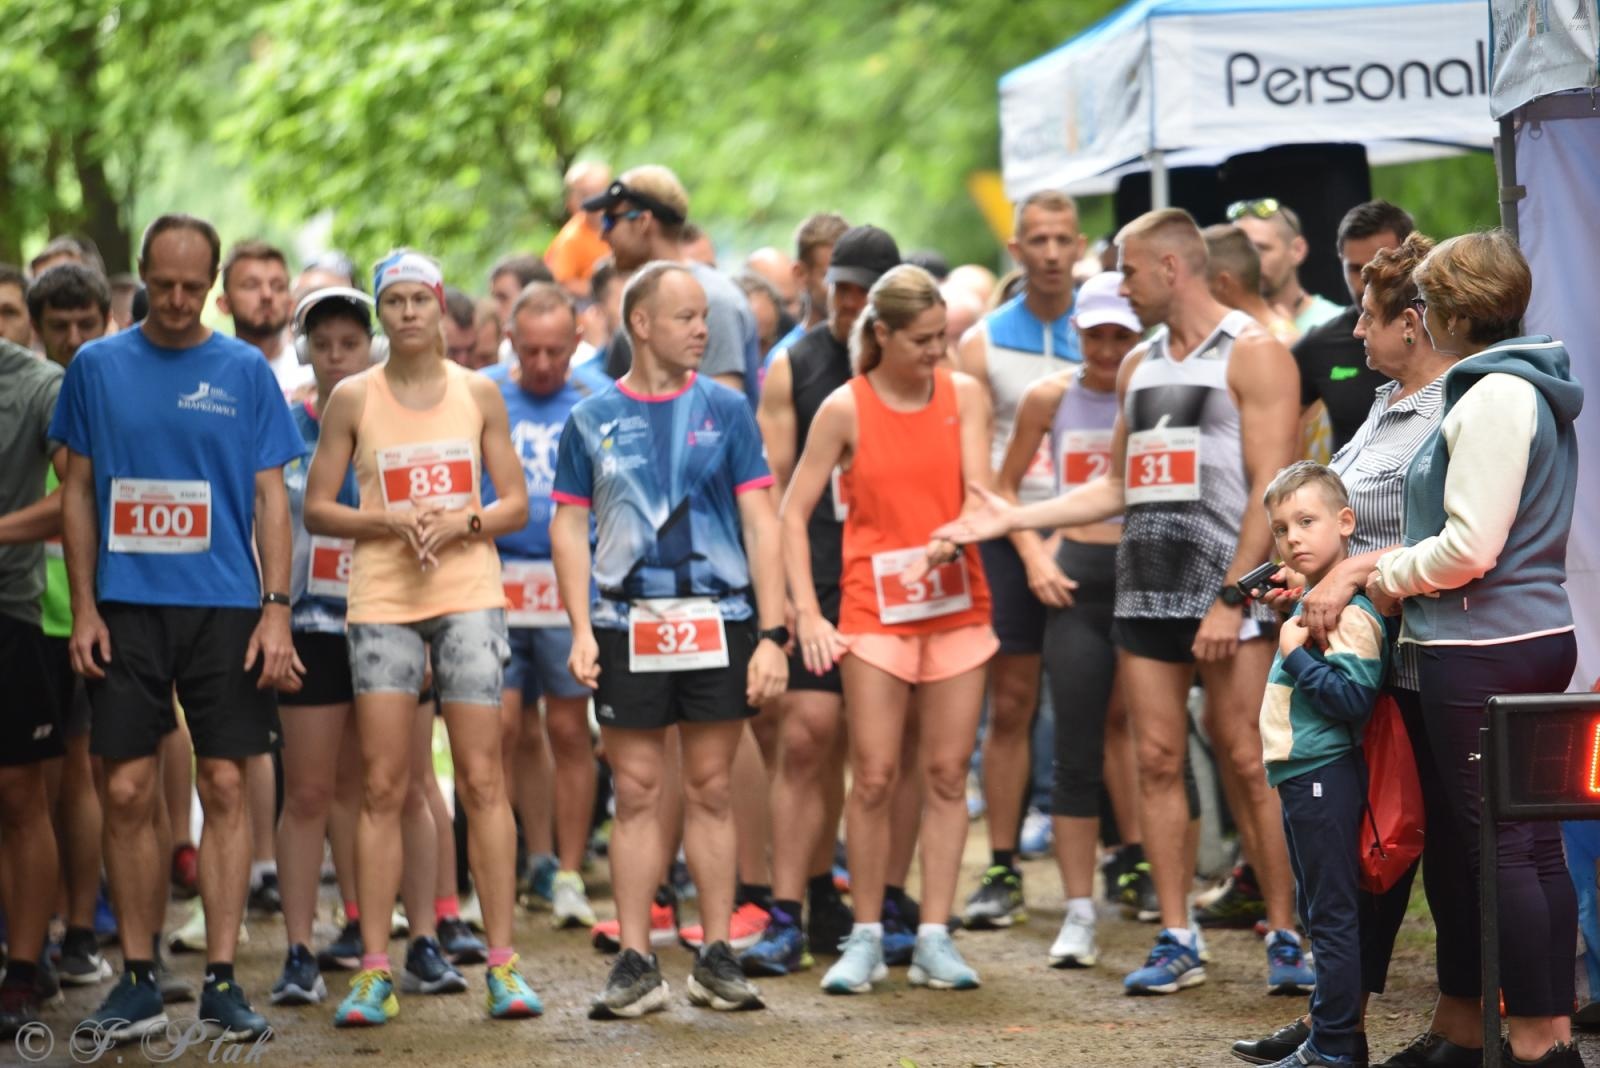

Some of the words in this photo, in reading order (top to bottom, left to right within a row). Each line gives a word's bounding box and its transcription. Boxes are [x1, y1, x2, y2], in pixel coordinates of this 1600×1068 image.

[1226, 39, 1487, 107] Personal
[409, 463, 453, 497] 83
[1140, 453, 1173, 485] 31
[130, 504, 194, 537] 100
[656, 621, 699, 654] 32
